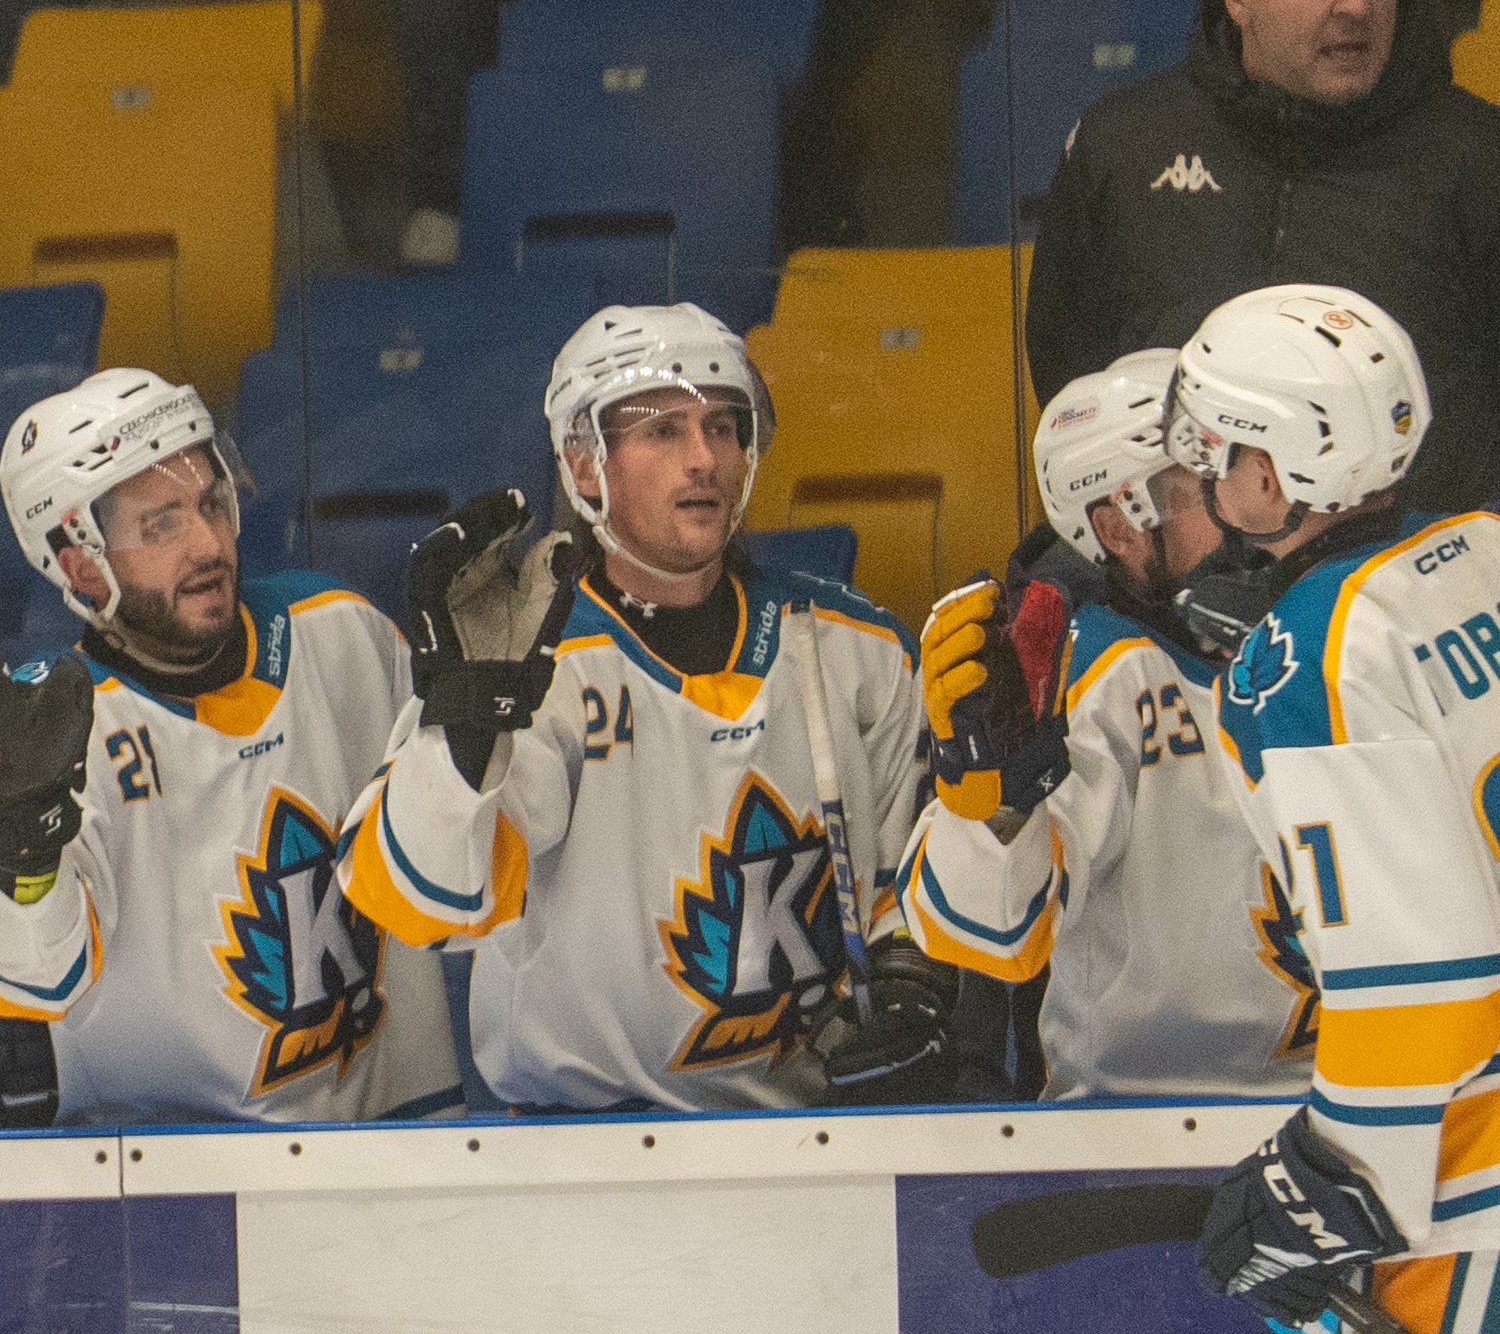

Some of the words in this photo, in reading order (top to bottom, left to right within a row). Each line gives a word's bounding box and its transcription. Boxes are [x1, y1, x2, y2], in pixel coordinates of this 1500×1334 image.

[1217, 414, 1269, 434] CCM
[1069, 469, 1108, 491] CCM
[26, 496, 54, 520] CCM
[1414, 535, 1471, 576] CCM
[710, 719, 765, 743] CCM
[1136, 683, 1205, 768] 23
[238, 732, 286, 761] CCM
